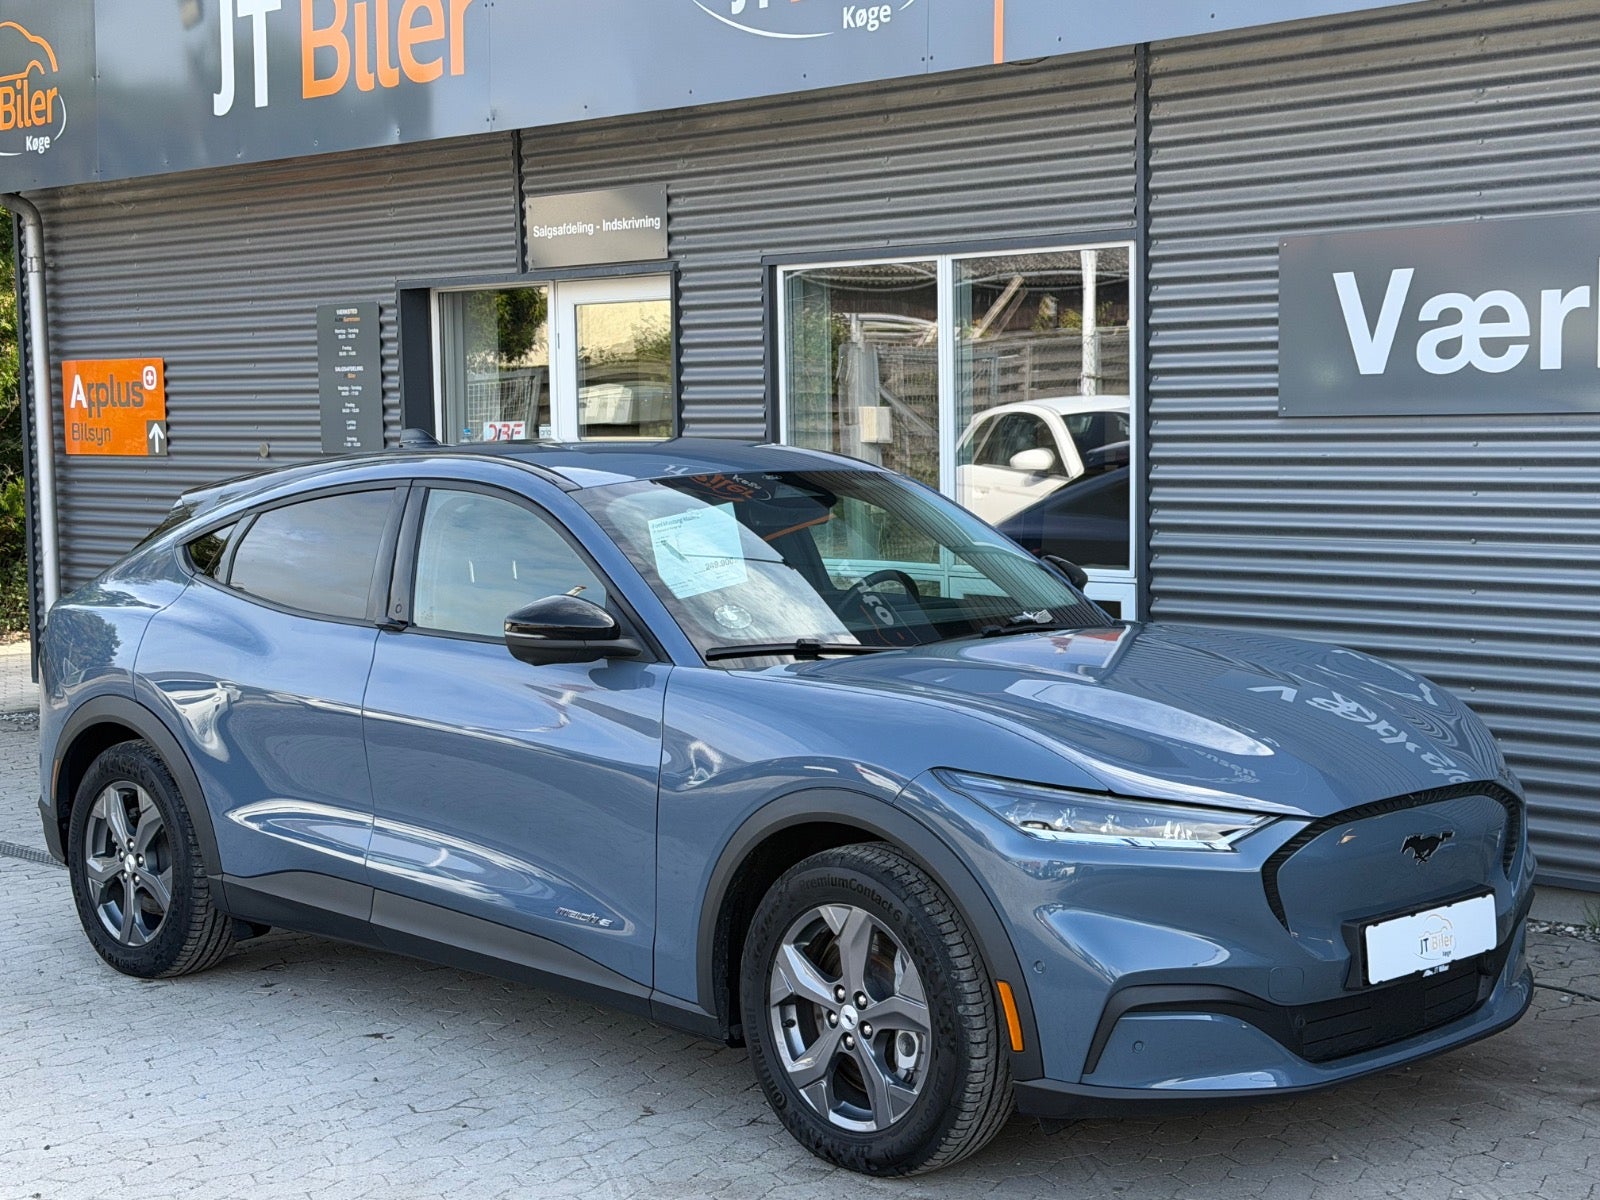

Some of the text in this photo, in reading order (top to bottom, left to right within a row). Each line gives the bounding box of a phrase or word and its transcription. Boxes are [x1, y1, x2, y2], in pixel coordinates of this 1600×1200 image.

[843, 5, 891, 31] Køge
[213, 0, 282, 116] JT
[0, 79, 58, 131] Biler
[26, 135, 51, 154] Køge
[533, 221, 594, 239] Salgsafdeling
[602, 215, 661, 231] Indskrivning
[1332, 267, 1600, 375] Vær
[71, 422, 112, 446] Bilsyn
